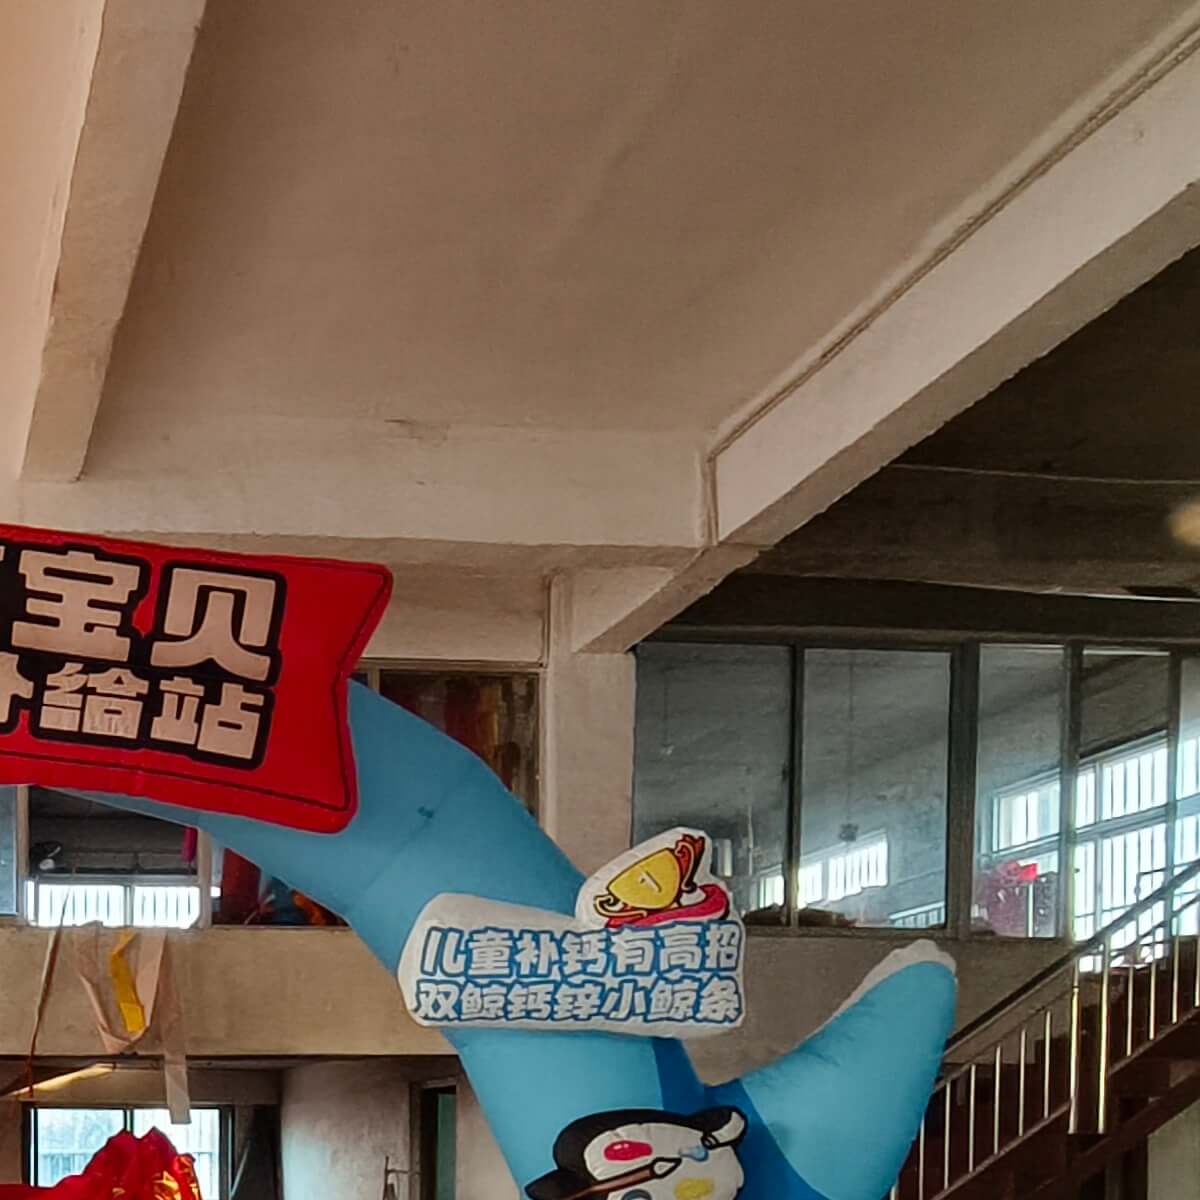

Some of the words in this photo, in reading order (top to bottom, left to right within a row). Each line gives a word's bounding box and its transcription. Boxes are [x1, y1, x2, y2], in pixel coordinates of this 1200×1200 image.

[421, 922, 741, 977] 儿童补钙有高招
[414, 978, 742, 1023] 双鲸钙锌小鲸条
